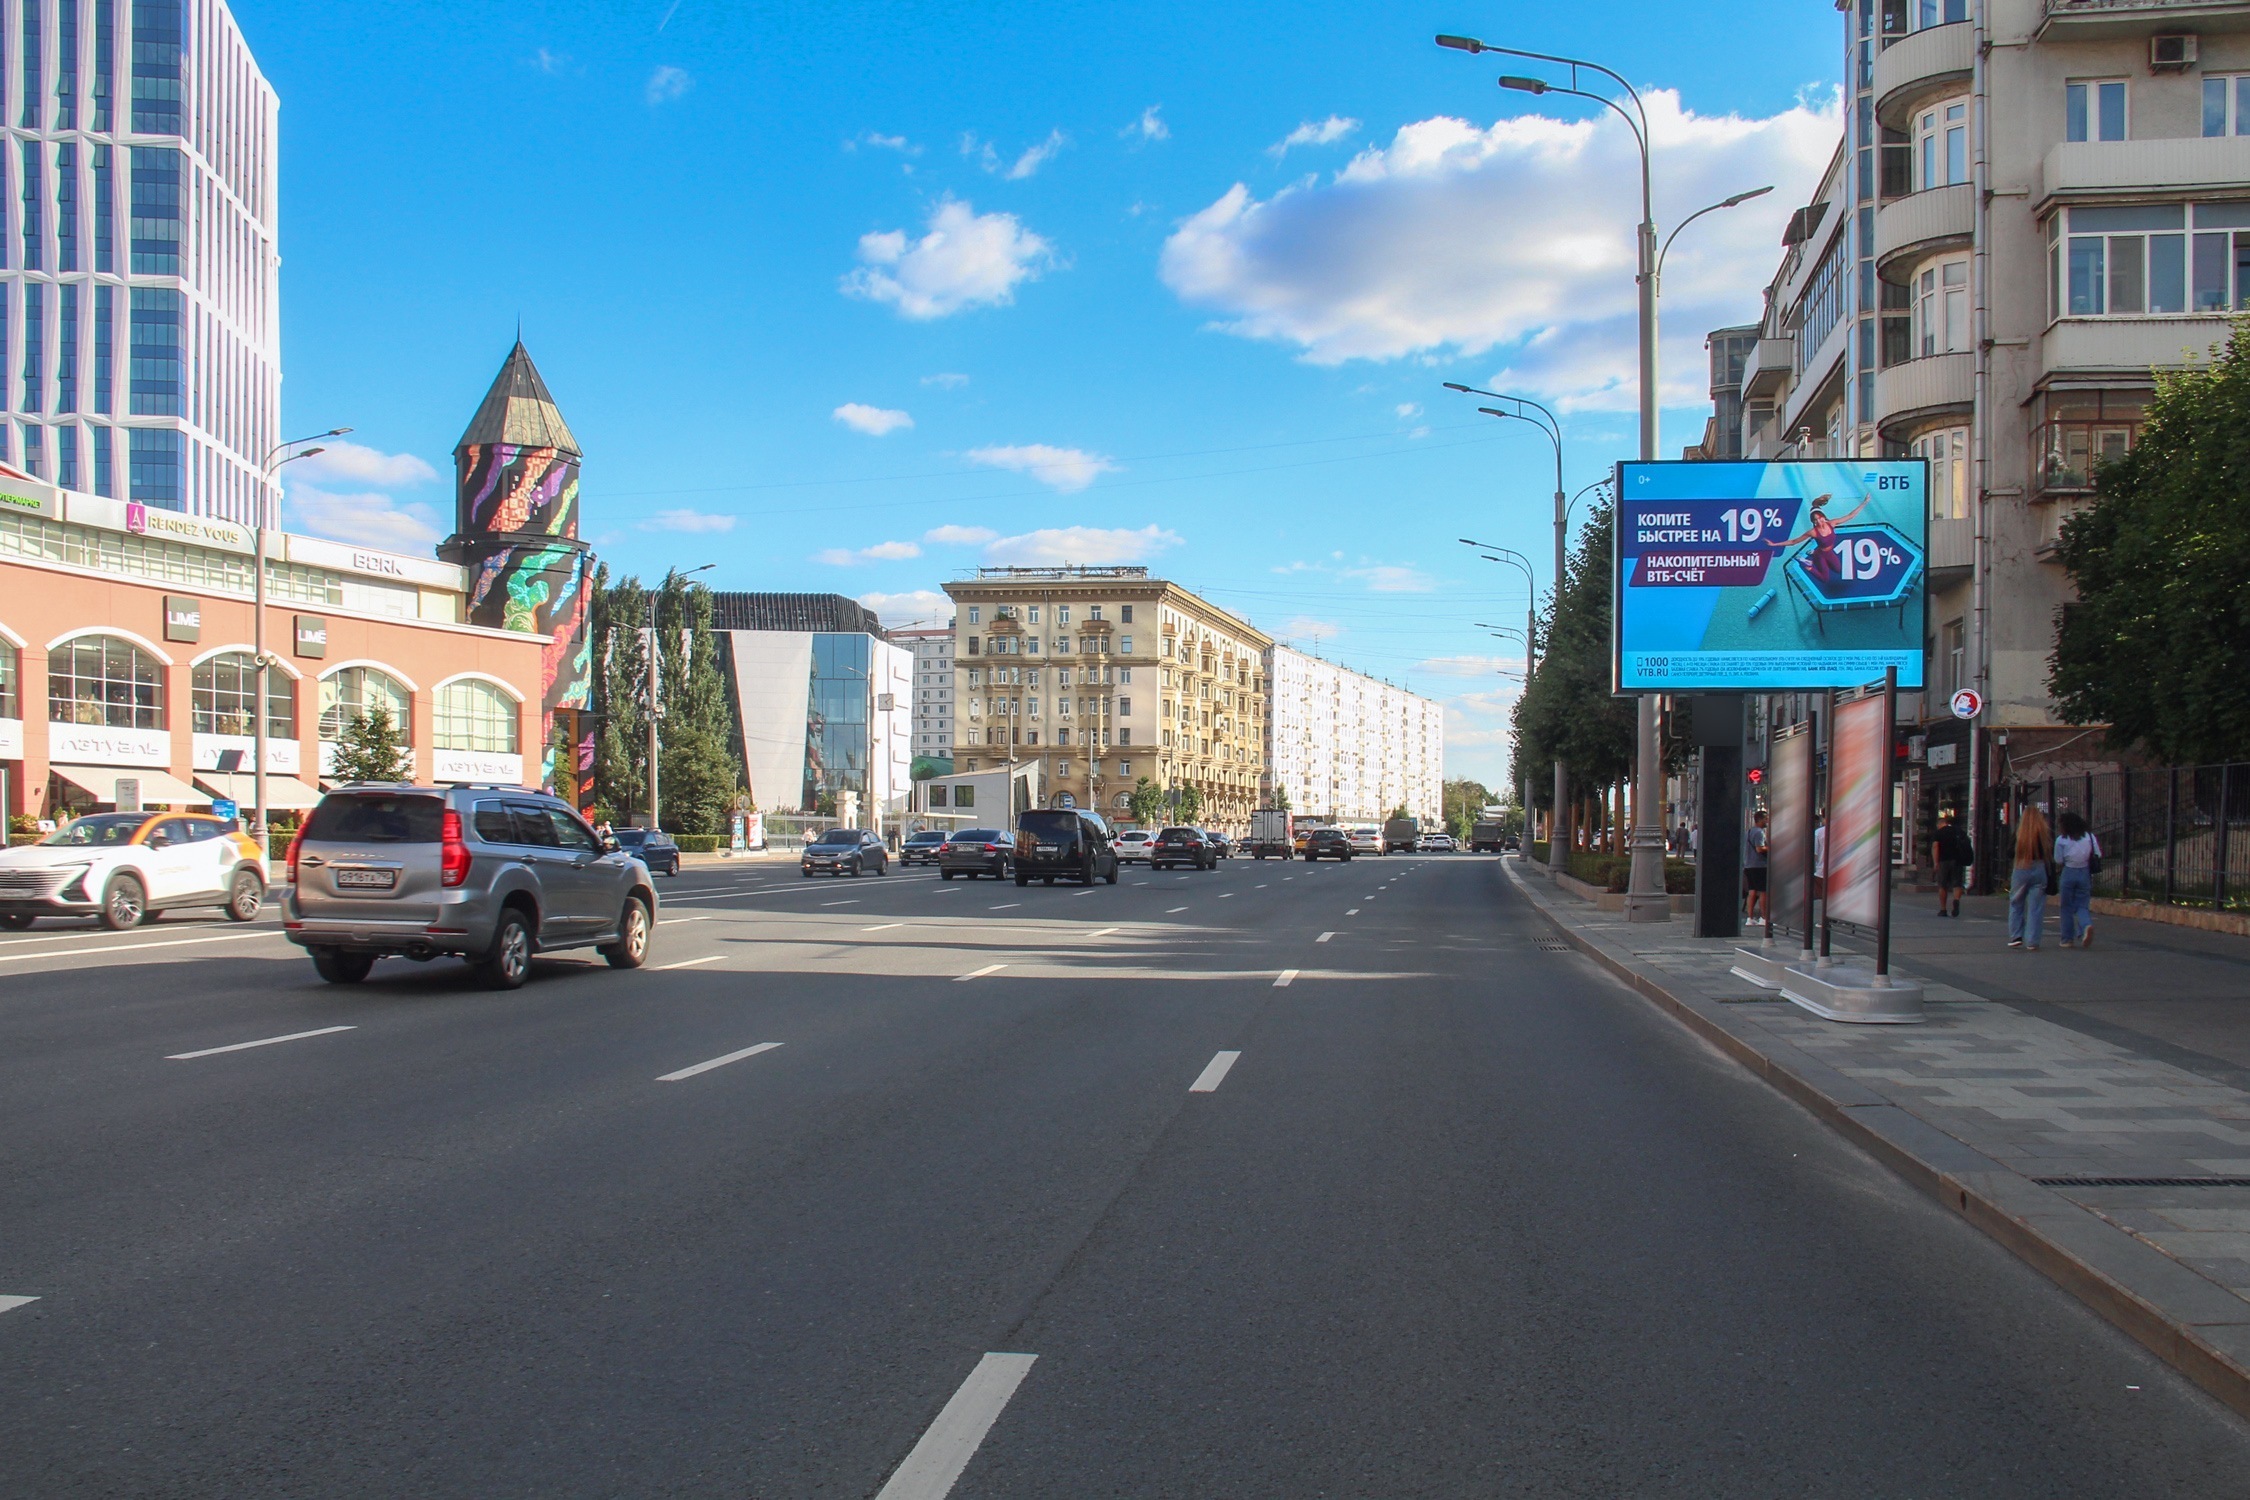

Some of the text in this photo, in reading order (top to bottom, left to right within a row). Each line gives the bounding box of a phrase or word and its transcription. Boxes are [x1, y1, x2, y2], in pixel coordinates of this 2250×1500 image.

[1638, 475, 1651, 485] 0+
[1878, 475, 1910, 490] ВТБ
[1637, 513, 1691, 526] КОПИТЕ
[1637, 530, 1699, 543] БЫСТРЕЕ
[1701, 529, 1721, 543] НА
[353, 552, 404, 576] BORK
[1647, 552, 1760, 568] НАКОПИТЕЛЬНЫЙ
[1832, 538, 1901, 581] 19%
[1647, 568, 1706, 583] ВТБ-СЧЁТ
[1645, 657, 1669, 667] 1000
[1637, 668, 1669, 677] VTB.RU
